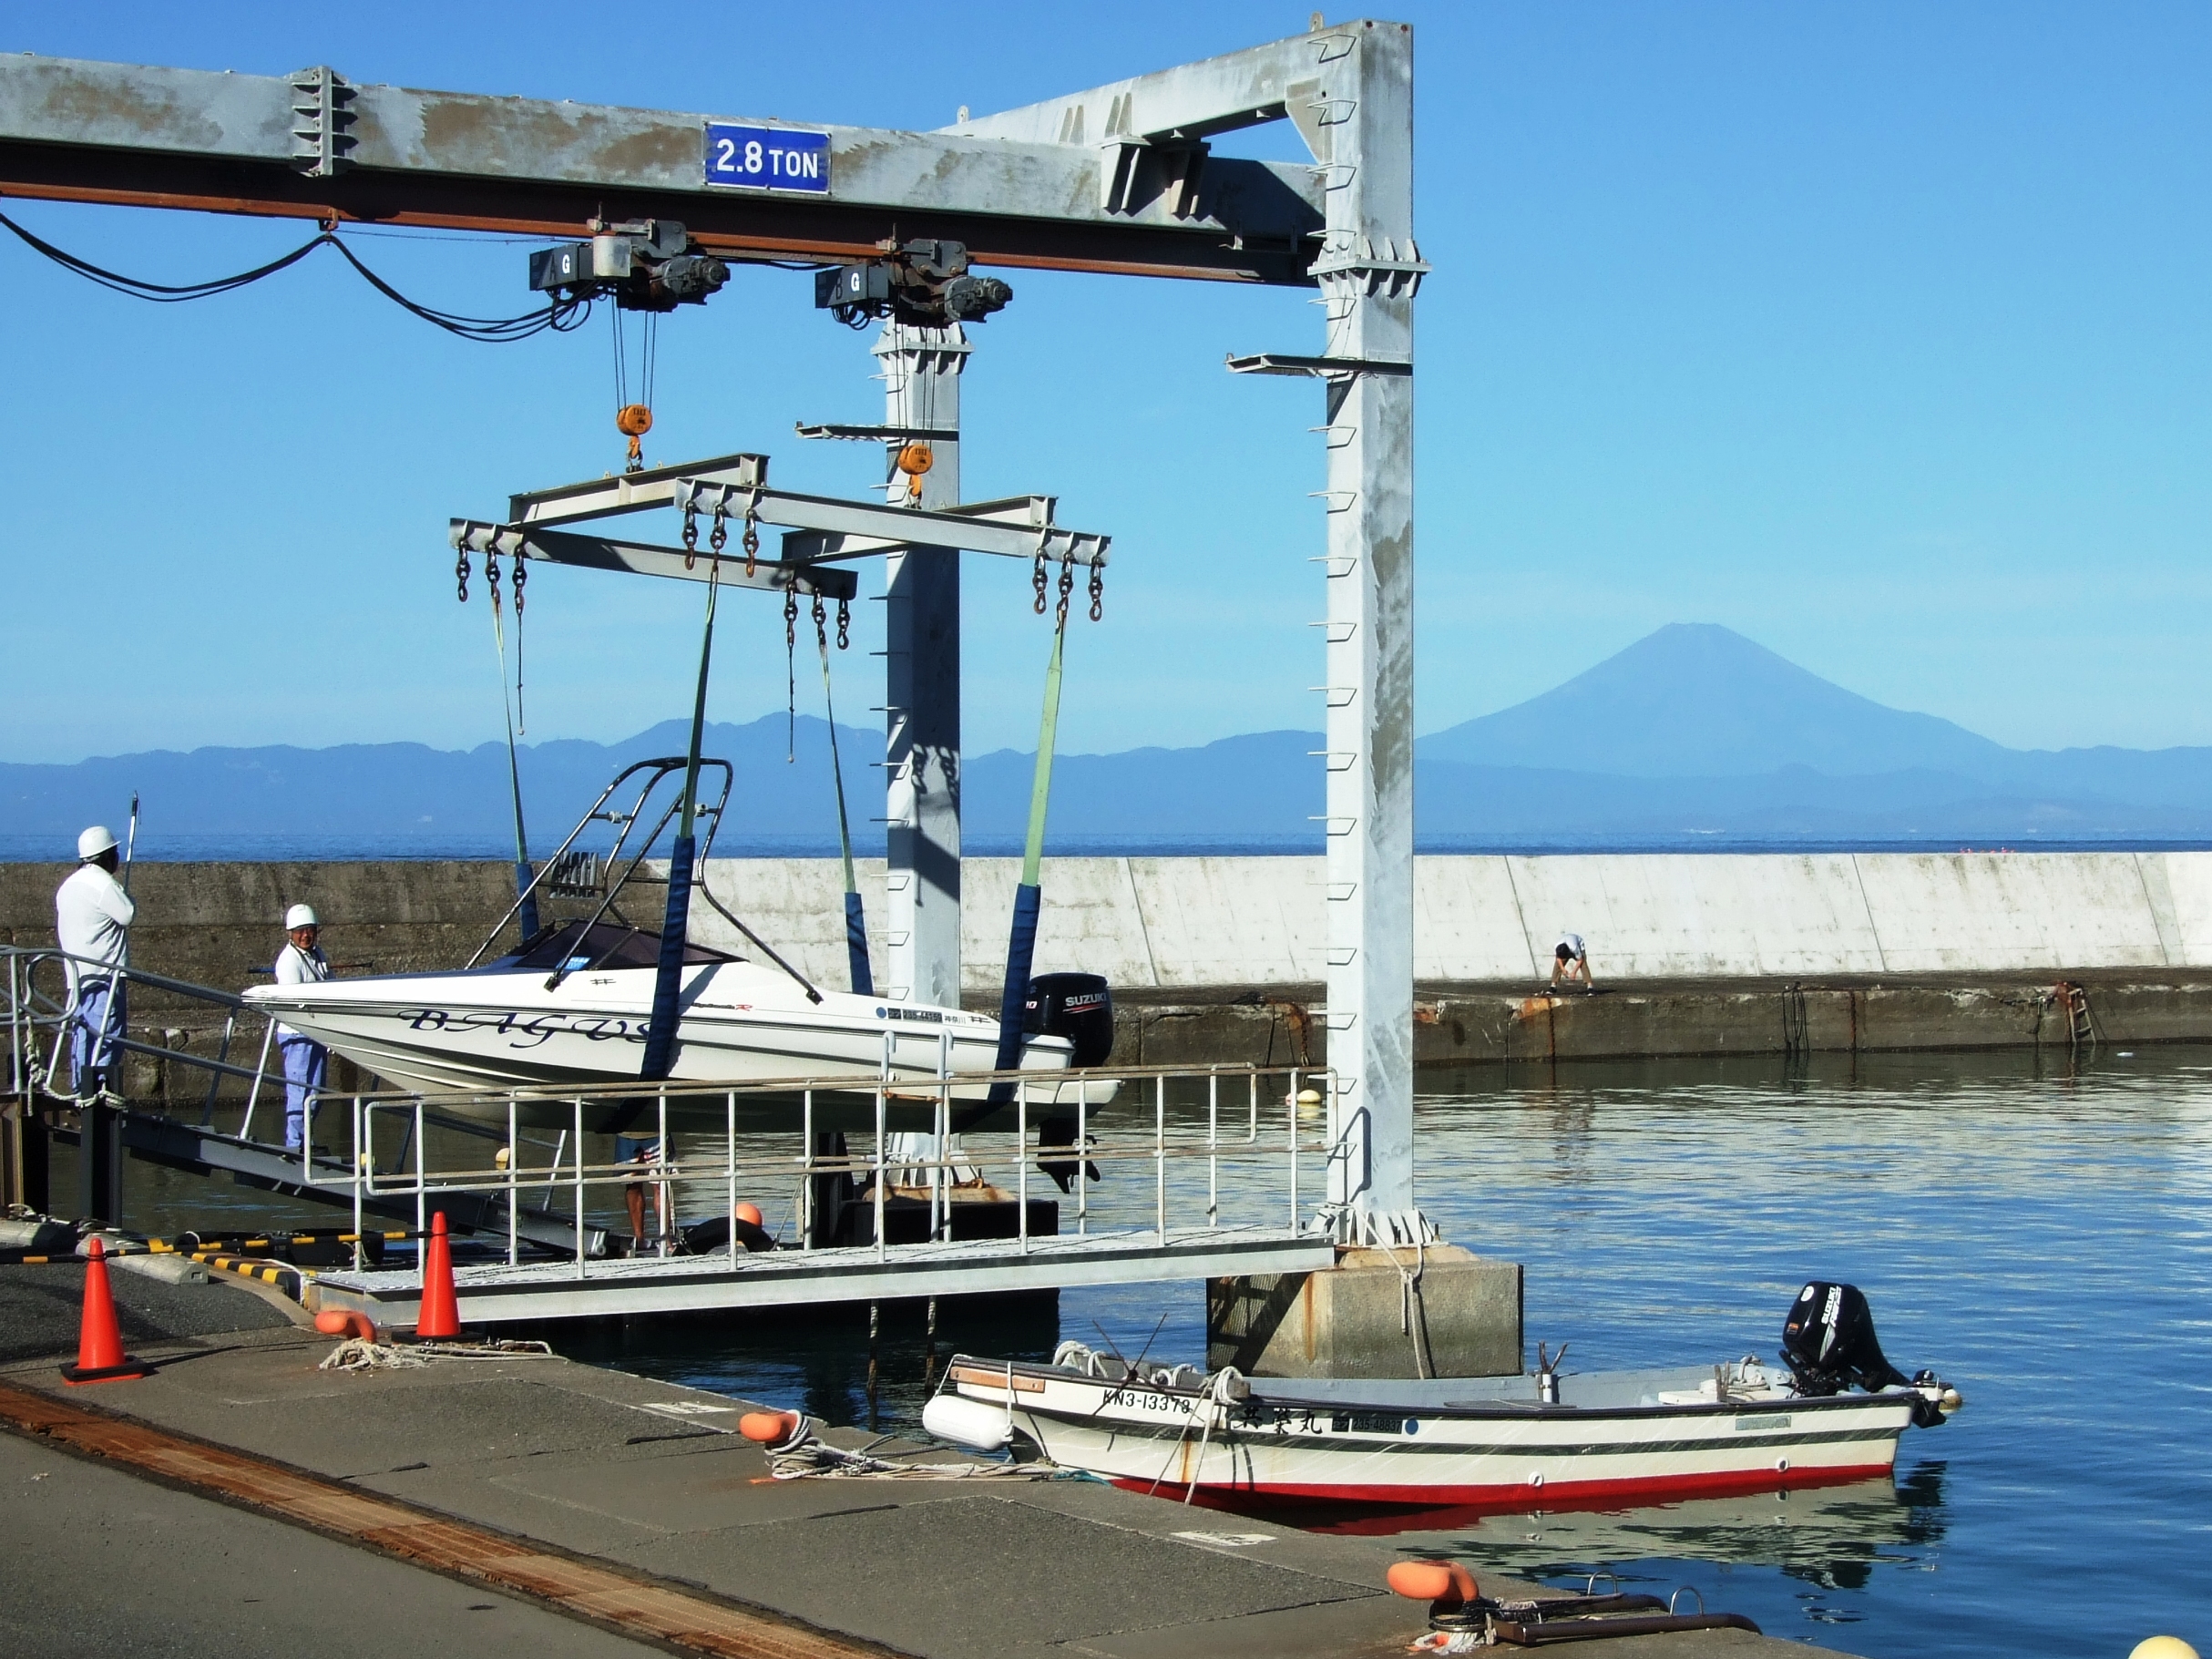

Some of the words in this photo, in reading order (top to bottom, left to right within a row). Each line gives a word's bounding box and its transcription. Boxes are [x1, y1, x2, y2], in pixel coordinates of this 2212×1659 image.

[716, 138, 763, 174] 2.8
[768, 148, 818, 179] TON
[562, 253, 570, 274] G
[850, 272, 860, 292] G
[1064, 992, 1107, 1007] SUZUKI
[1821, 1286, 1837, 1325] SUZUKI
[1102, 1388, 1191, 1414] KN3-13378
